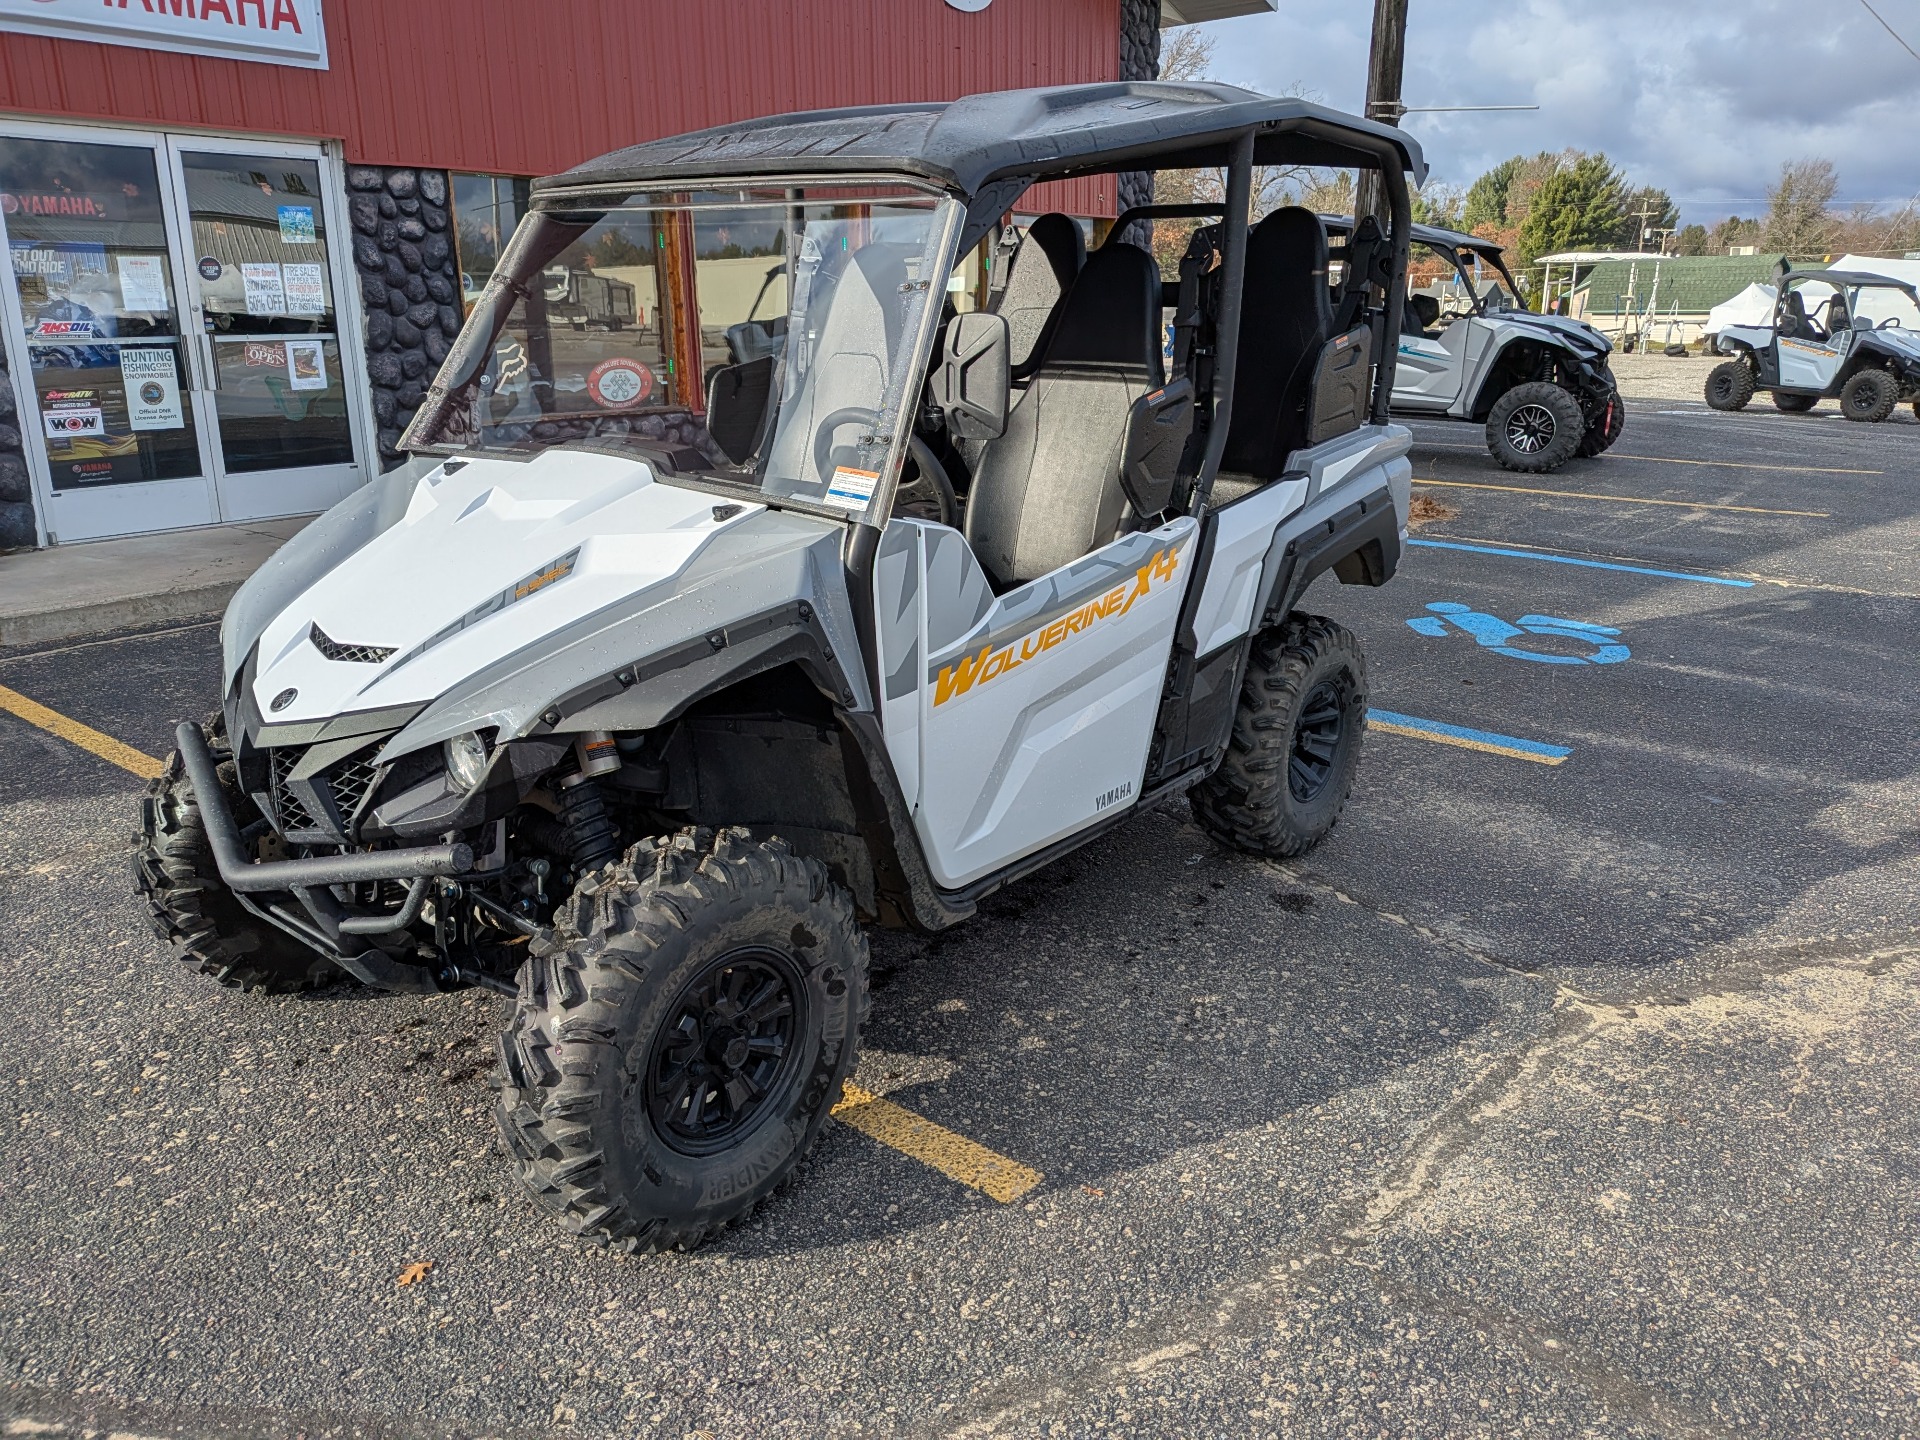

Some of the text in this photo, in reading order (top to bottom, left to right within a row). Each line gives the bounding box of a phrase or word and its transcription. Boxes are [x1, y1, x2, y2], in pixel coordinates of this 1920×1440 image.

[18, 195, 96, 215] YAMAHA
[31, 249, 55, 262] OUT
[14, 260, 66, 274] AND RIDE
[285, 266, 299, 276] TIRE
[267, 295, 283, 311] OFF
[37, 322, 92, 334] AMSOIL
[121, 351, 172, 362] HUNTING
[249, 349, 285, 365] OPEN
[123, 362, 156, 372] FISHING
[48, 416, 98, 432] WOW
[81, 463, 112, 471] YAMAHA
[933, 547, 1178, 707] WOLVERINE X4
[1095, 781, 1132, 812] YAMAHA
